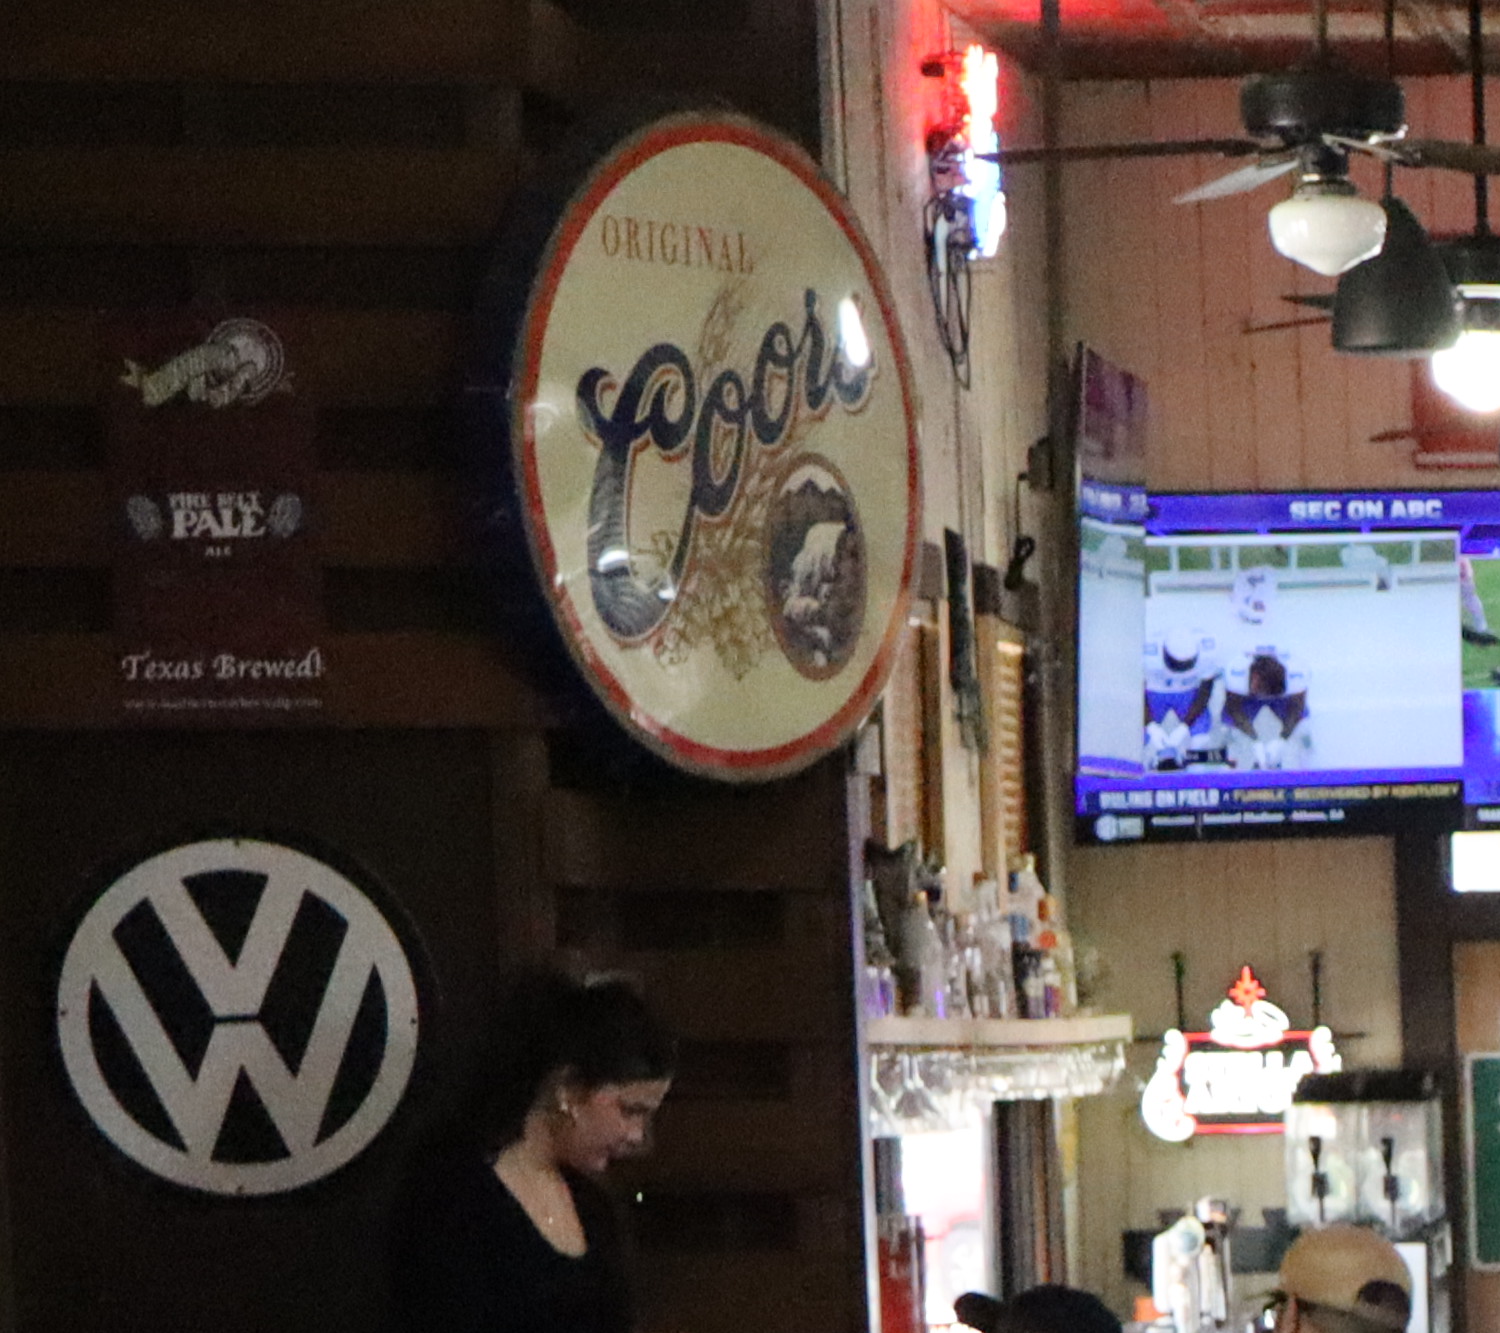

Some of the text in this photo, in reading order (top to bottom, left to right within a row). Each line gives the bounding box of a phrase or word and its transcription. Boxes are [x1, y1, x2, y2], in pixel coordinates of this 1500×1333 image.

[602, 213, 757, 277] ORIGINAL
[170, 507, 267, 540] PALE
[1288, 498, 1443, 520] SEC ON ABC
[121, 647, 325, 681] Texas Brewed!
